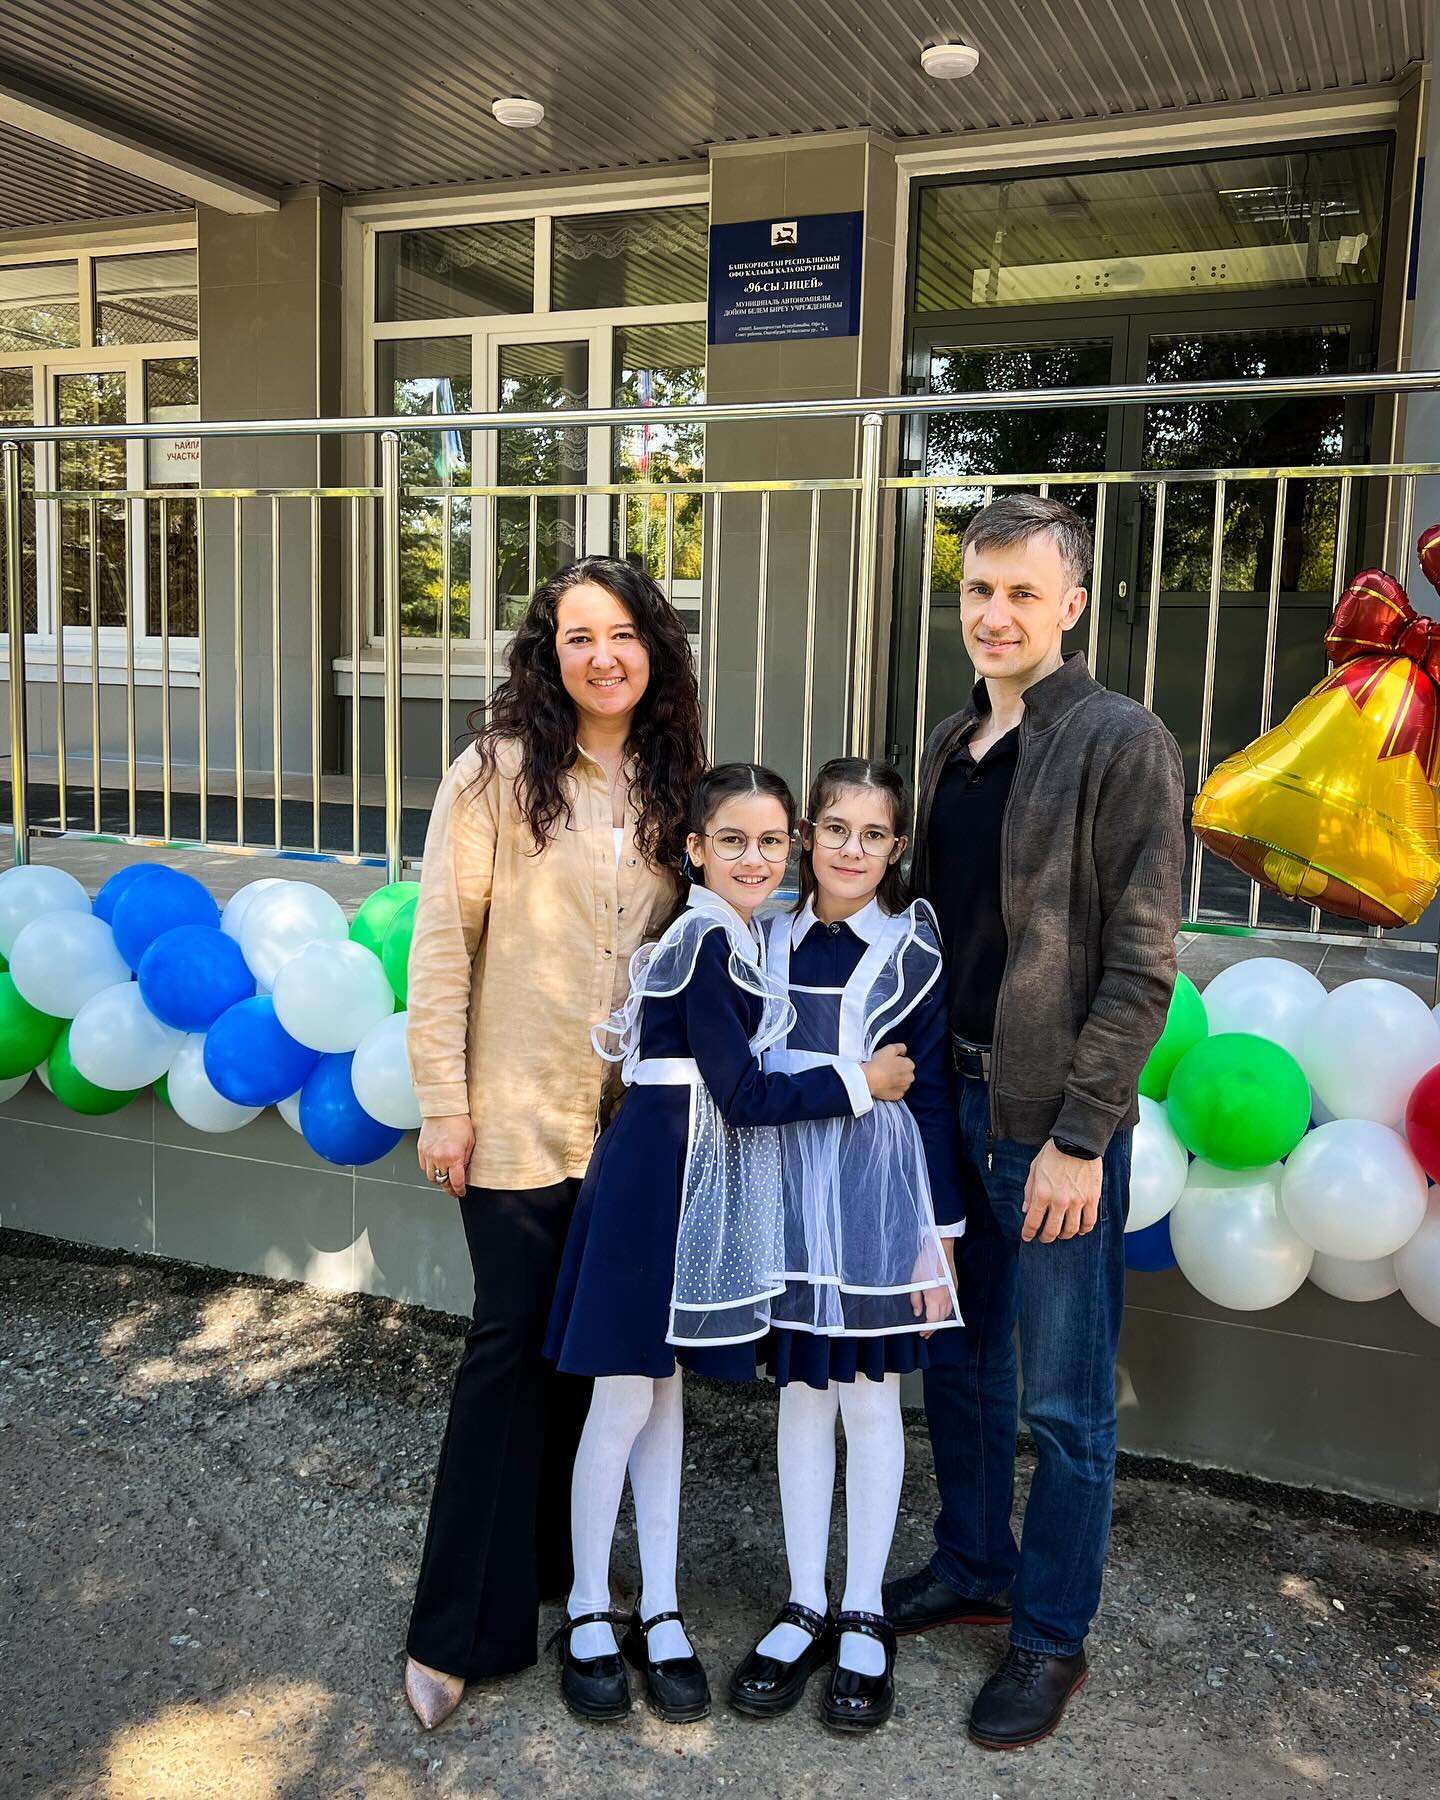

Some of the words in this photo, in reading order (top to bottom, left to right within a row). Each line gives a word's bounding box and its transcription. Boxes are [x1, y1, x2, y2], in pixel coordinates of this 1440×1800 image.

[728, 260, 784, 270] БАШКОРТОСТАН
[743, 281, 780, 293] «96-СЫ
[781, 277, 823, 291] ЛИЦЕЙ»
[735, 298, 780, 308] МУНИЦИПАЛЬ
[780, 294, 831, 305] АВТОНОМИЯЛЫ
